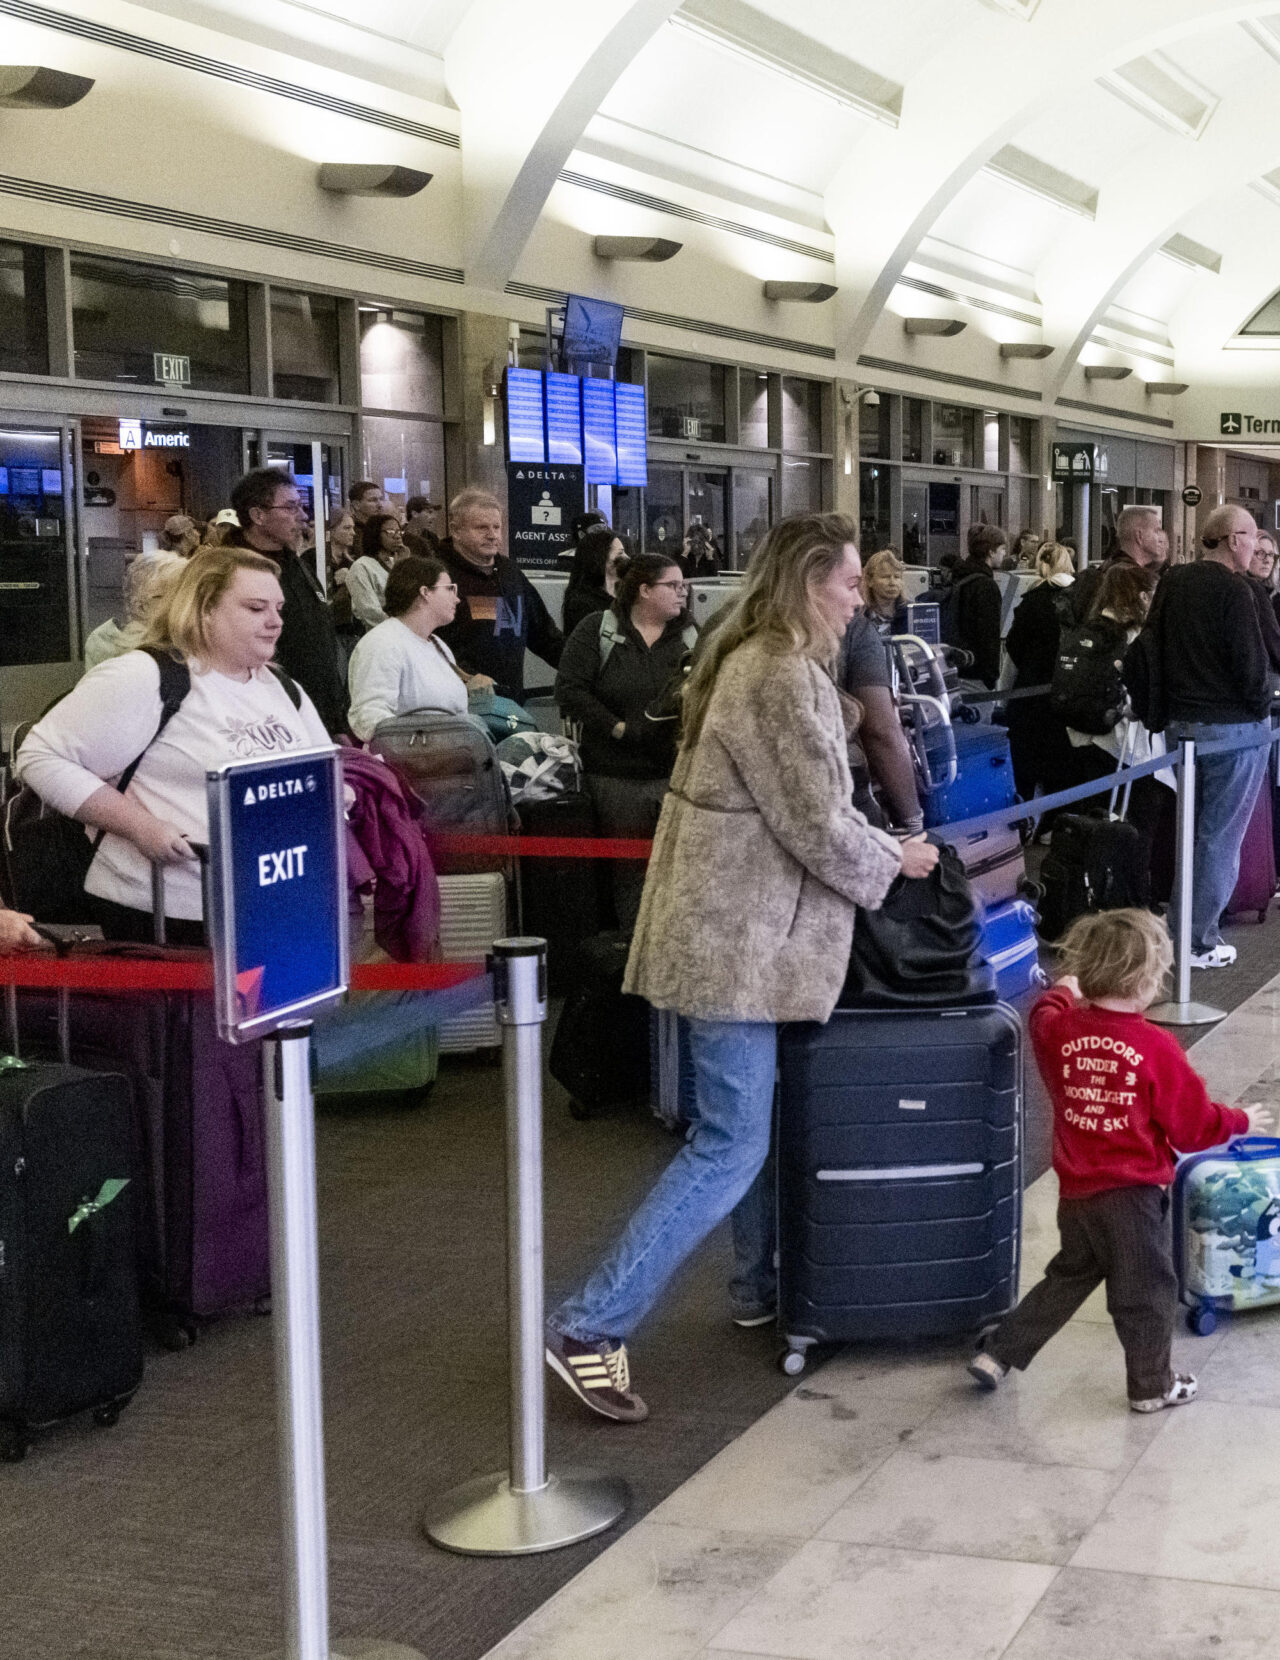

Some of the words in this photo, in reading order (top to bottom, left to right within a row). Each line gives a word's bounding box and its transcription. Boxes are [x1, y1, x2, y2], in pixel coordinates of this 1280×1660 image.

[162, 355, 184, 381] EXIT
[528, 470, 565, 480] DELTA
[515, 531, 546, 541] AGENT
[516, 557, 543, 565] SERVICES
[258, 778, 304, 801] DELTA
[258, 844, 308, 887] EXIT
[1061, 1035, 1144, 1066] OUTDOORS
[1076, 1057, 1119, 1074] UNDER
[1090, 1075, 1106, 1086] THE
[1083, 1104, 1105, 1114] AND
[1064, 1107, 1098, 1131] OPEN
[1103, 1114, 1129, 1132] SKY
